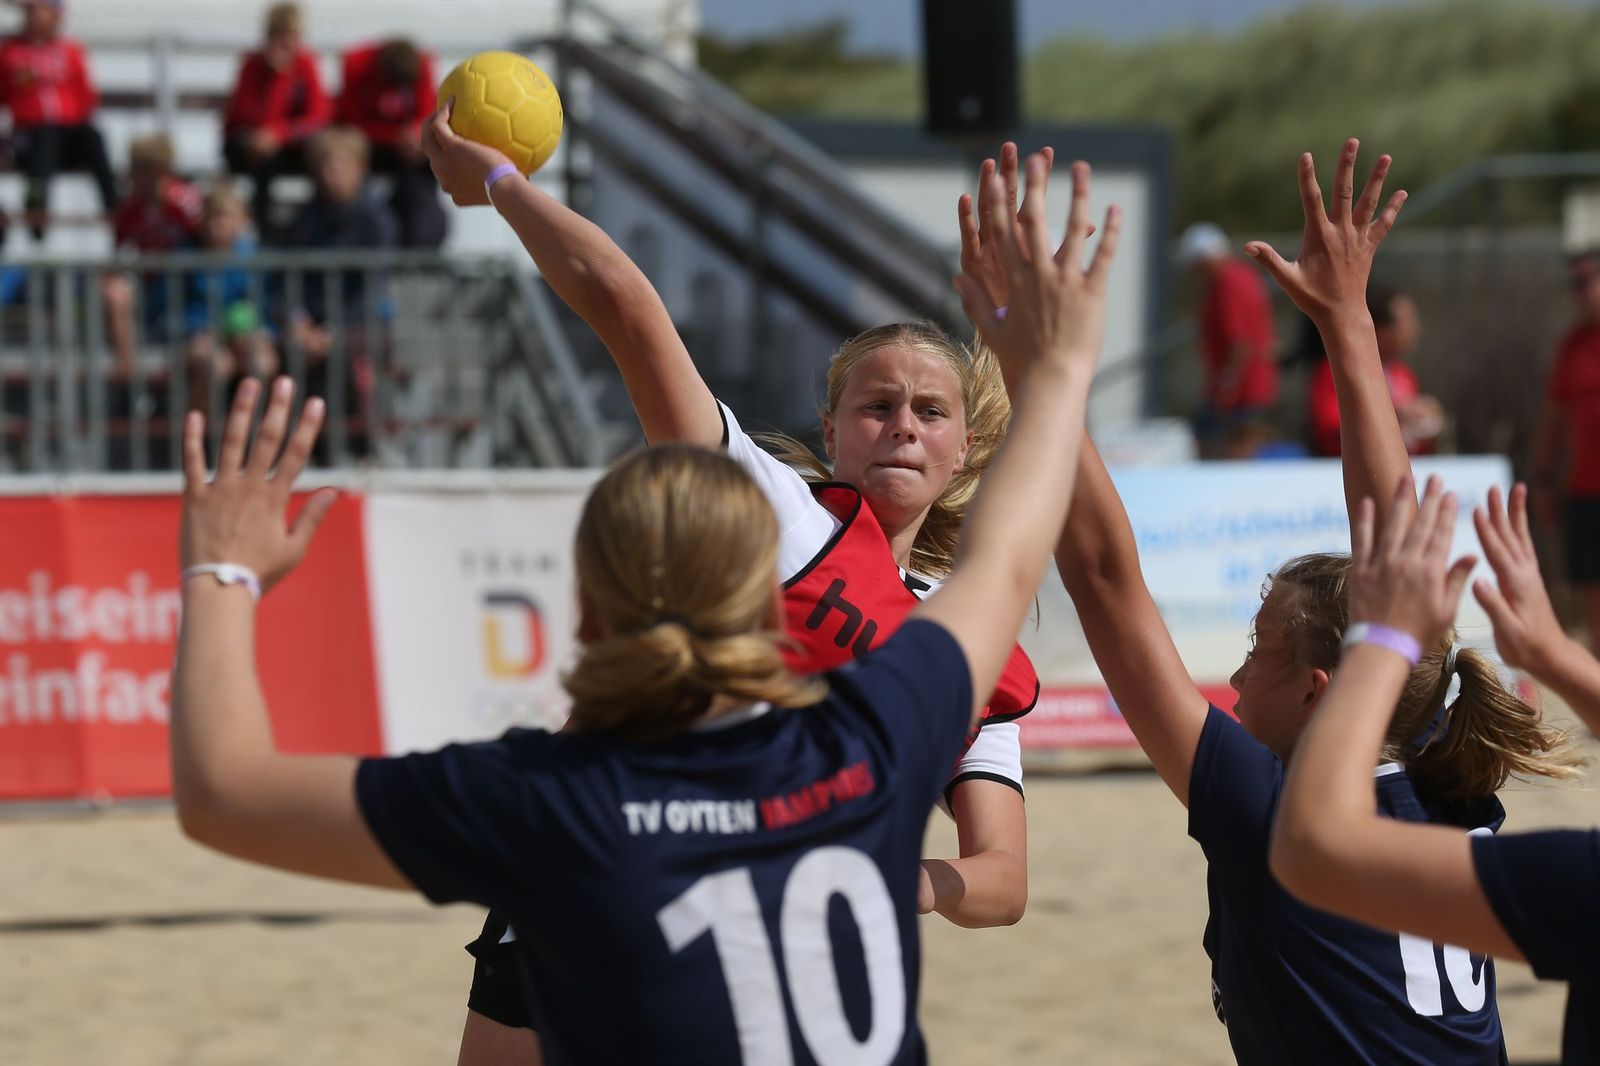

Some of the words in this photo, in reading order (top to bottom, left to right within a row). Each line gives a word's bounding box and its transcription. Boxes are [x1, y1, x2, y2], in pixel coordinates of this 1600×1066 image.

[621, 799, 661, 835] TV
[664, 798, 757, 835] OYTEN
[656, 845, 906, 1066] 10
